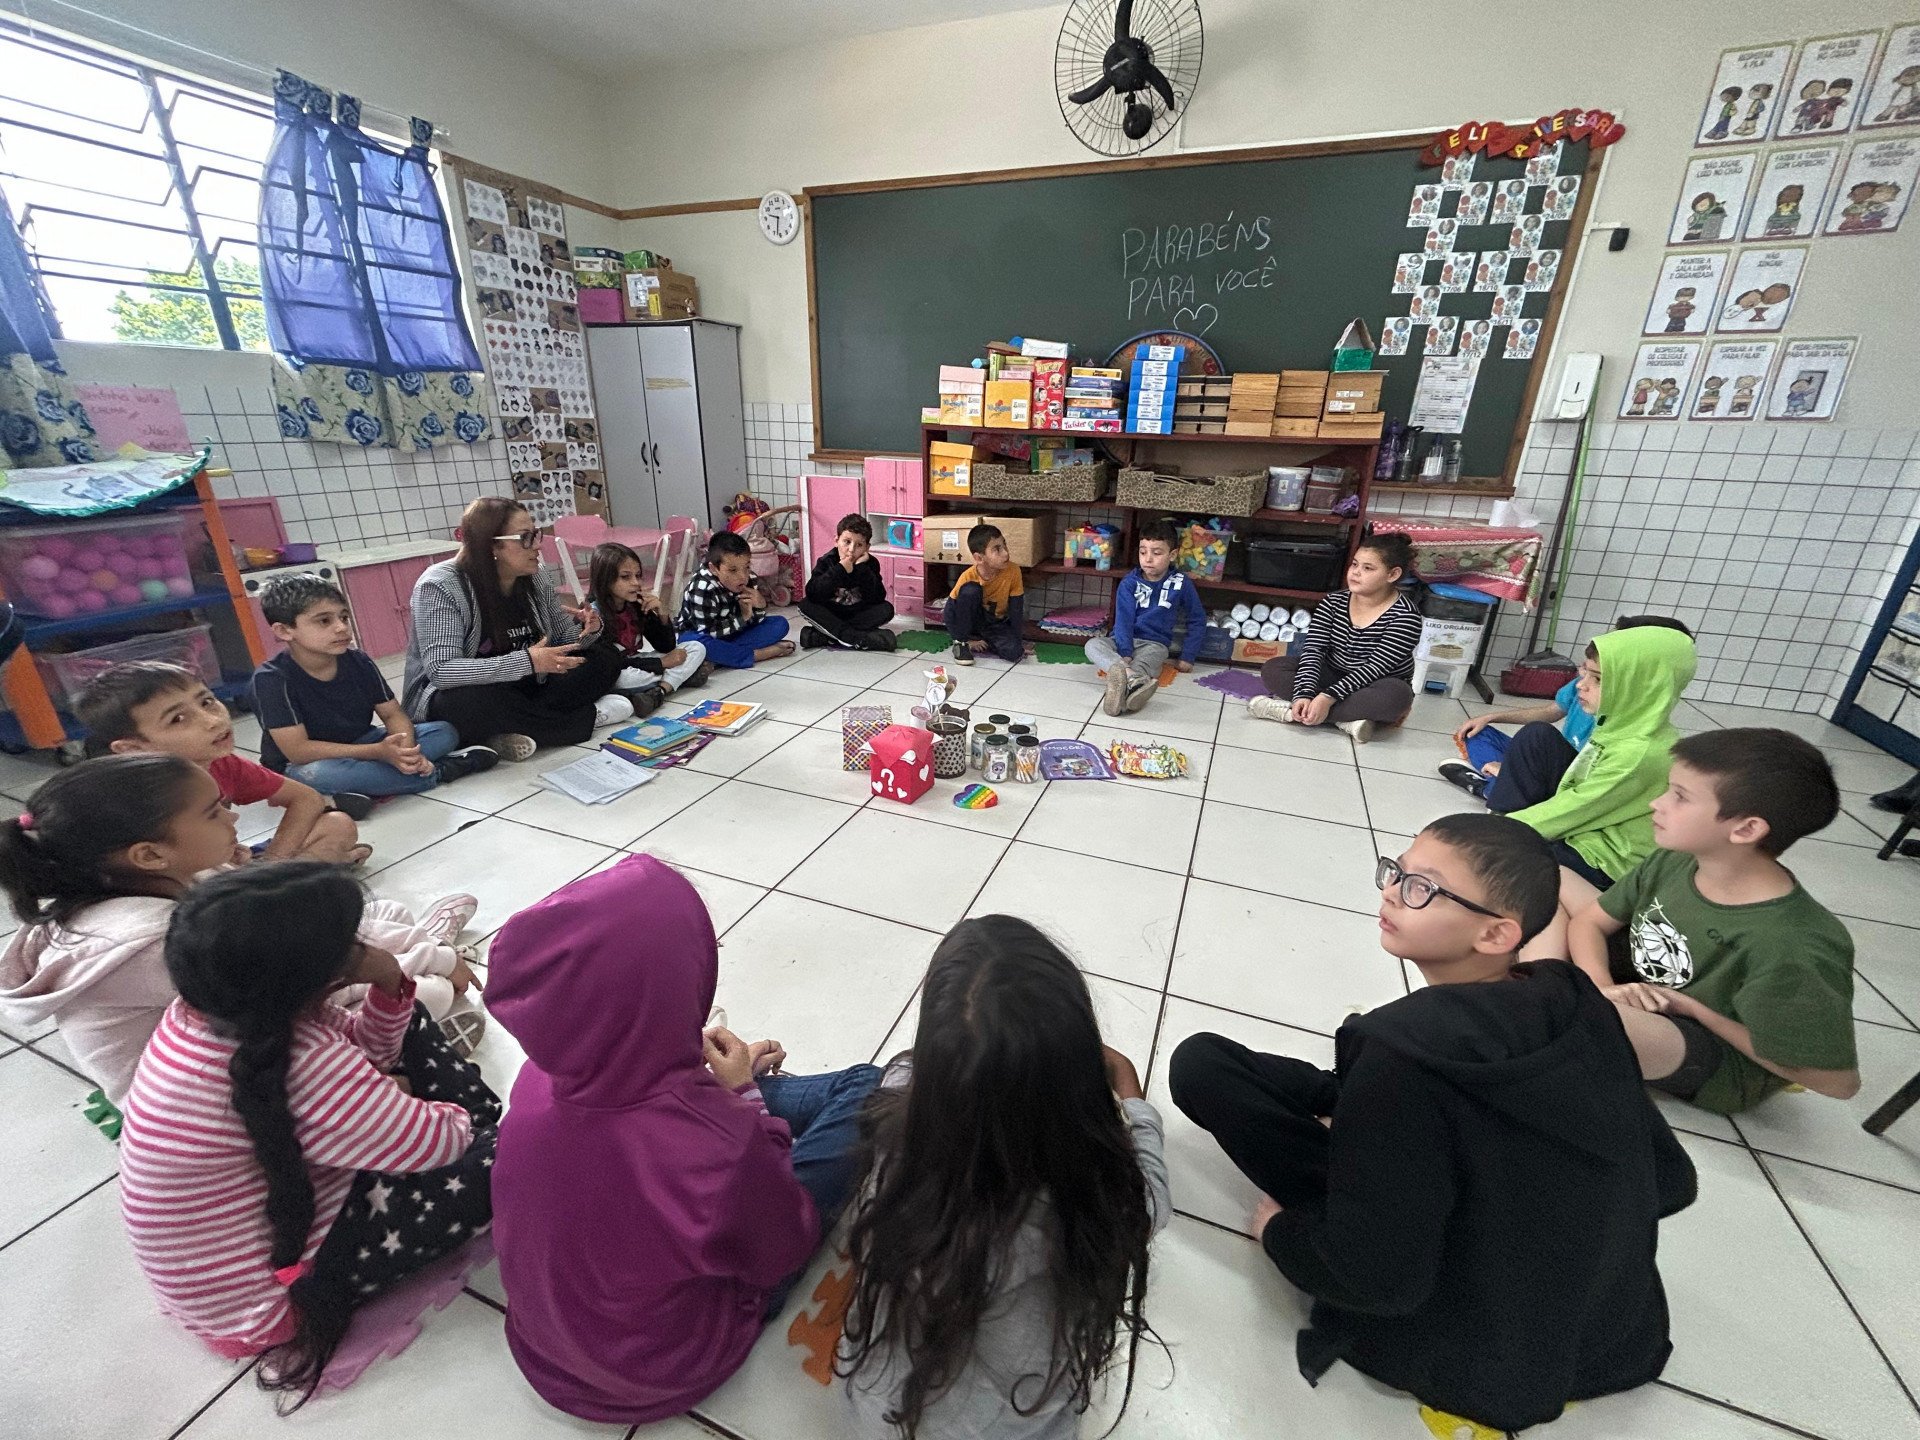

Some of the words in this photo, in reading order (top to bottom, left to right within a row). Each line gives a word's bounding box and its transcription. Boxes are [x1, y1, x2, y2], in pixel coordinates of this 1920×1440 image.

[1122, 210, 1271, 279] PARABÉNS
[1128, 274, 1195, 320] PARA
[1216, 256, 1277, 294] VOCÊ
[1064, 420, 1087, 429] Twister
[1425, 621, 1442, 629] LIXO
[1443, 624, 1481, 632] ORGÂNICO
